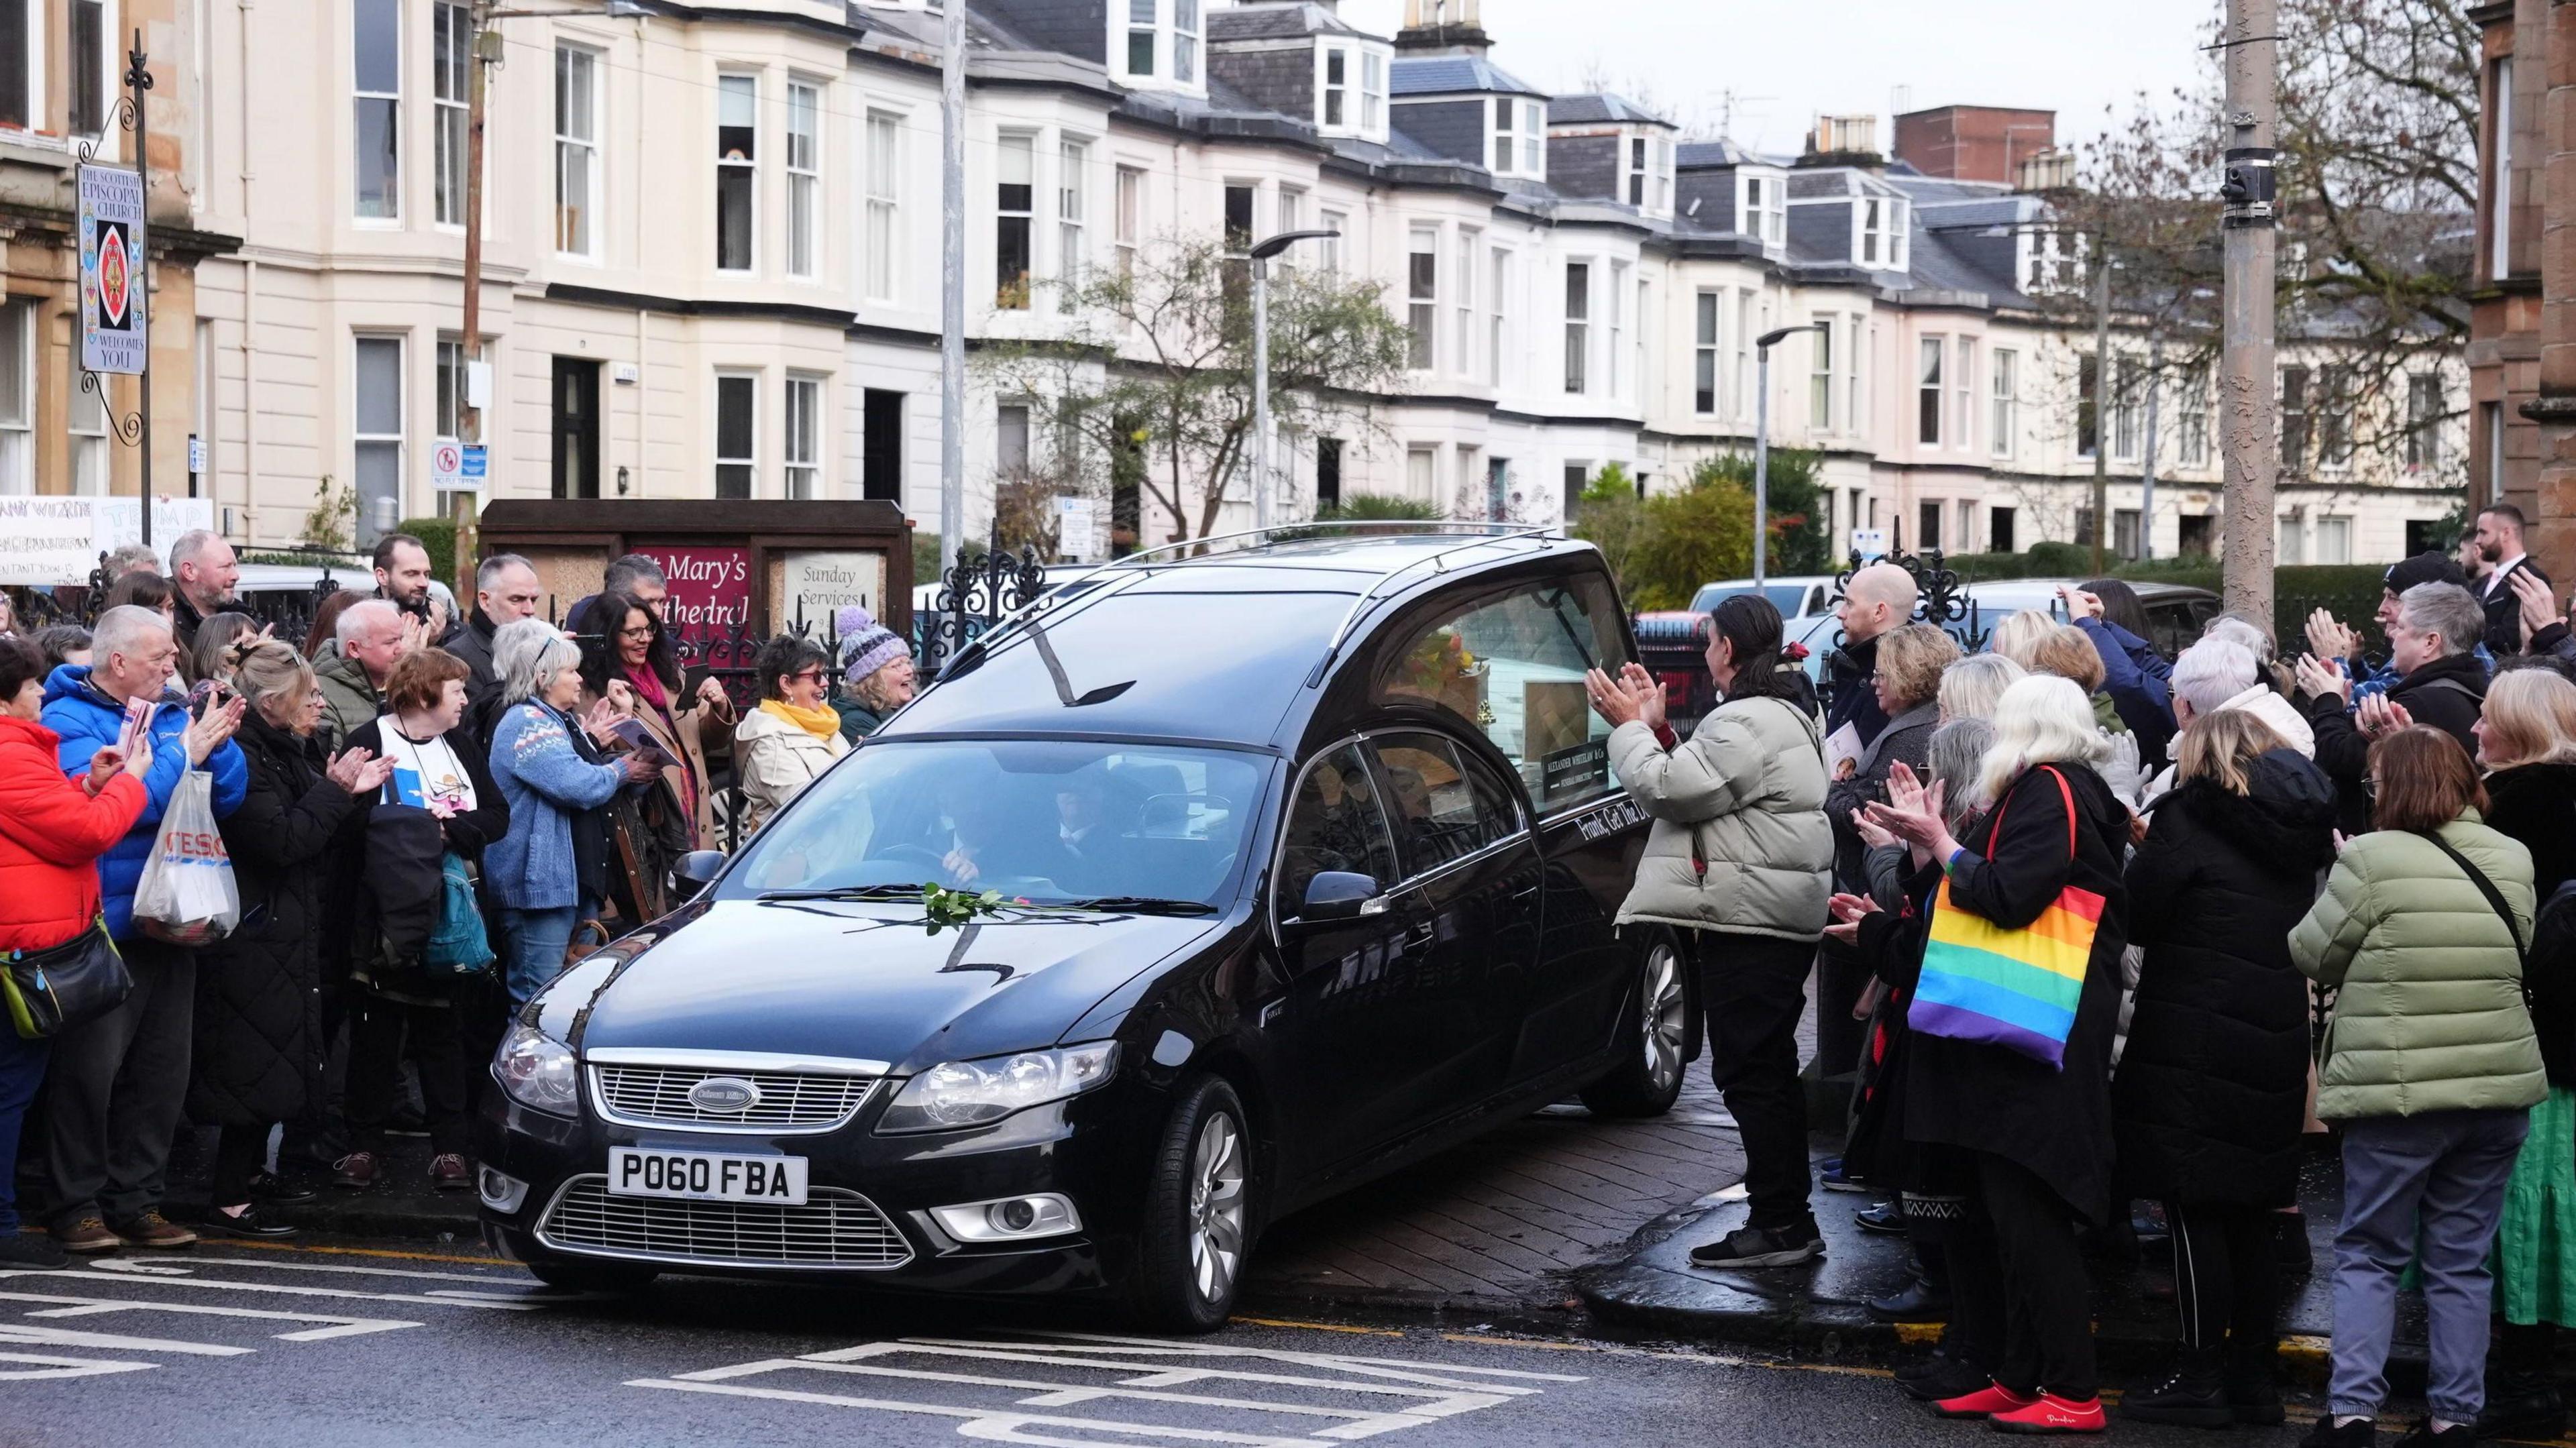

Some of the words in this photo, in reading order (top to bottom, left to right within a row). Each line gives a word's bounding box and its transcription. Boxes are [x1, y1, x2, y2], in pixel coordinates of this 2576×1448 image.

[83, 169, 98, 182] THE
[99, 172, 140, 187] SCOTTISH
[83, 182, 140, 205] EPISCOPAL
[98, 202, 141, 220] CHURCH
[99, 335, 144, 350] WELCOMES
[101, 349, 129, 368] YOU
[666, 553, 746, 589] Mary's
[803, 565, 856, 588] Sunday
[801, 589, 859, 606] Services
[663, 595, 749, 625] thedral
[1548, 757, 1572, 773] ALEXANDER
[1571, 750, 1594, 766] WHITELAW
[1560, 777, 1574, 787] FUNERAL
[1574, 771, 1593, 781] DIRECTORS
[1574, 812, 1610, 841] Frank,
[1603, 807, 1624, 831] Get
[1616, 801, 1639, 826] The
[623, 1154, 710, 1192] PO60
[720, 1160, 790, 1197] FBA
